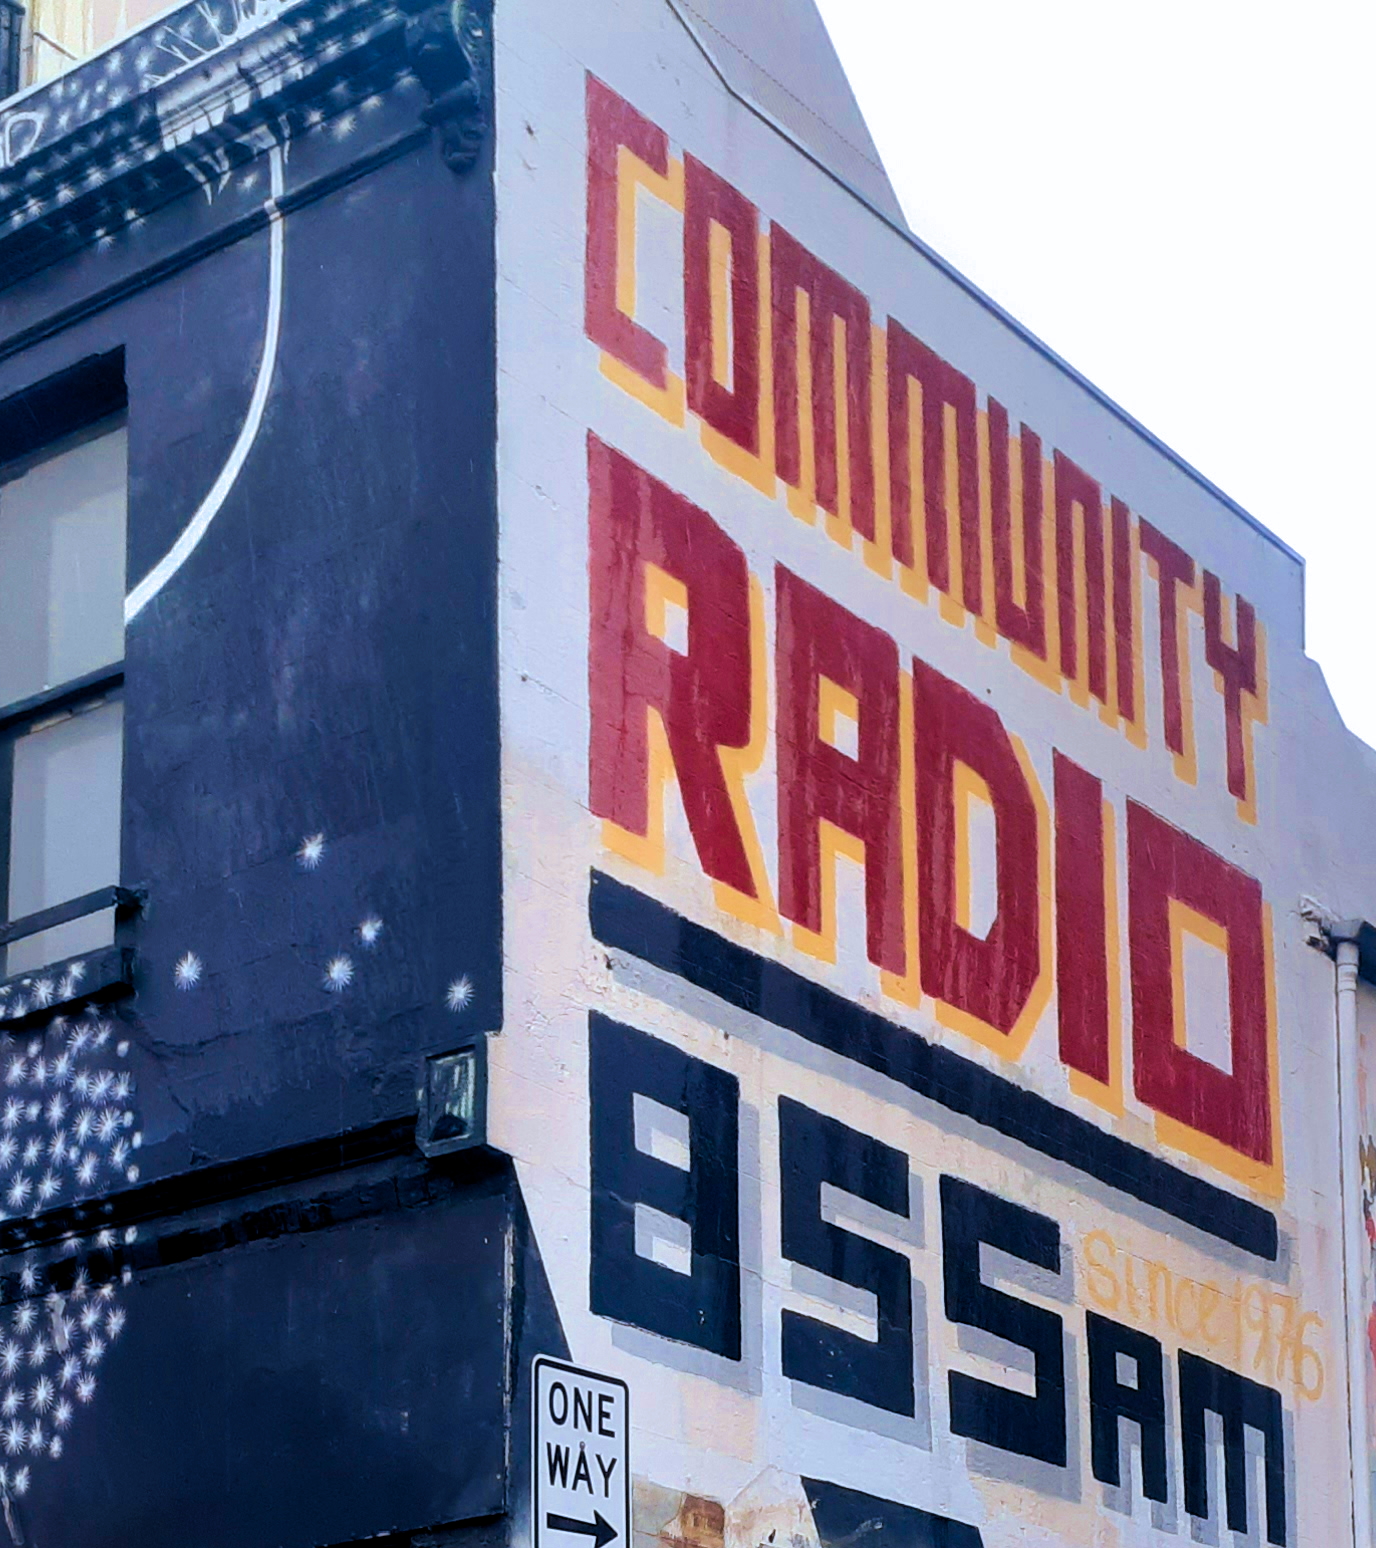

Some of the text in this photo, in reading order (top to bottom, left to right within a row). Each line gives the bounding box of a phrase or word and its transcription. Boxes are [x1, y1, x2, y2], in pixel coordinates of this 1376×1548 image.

[585, 71, 1268, 826] COMMUNITY
[586, 430, 1284, 1199] RADIO
[1234, 1276, 1324, 1401] 1976
[545, 1441, 617, 1500] WAY
[548, 1383, 617, 1440] ONE
